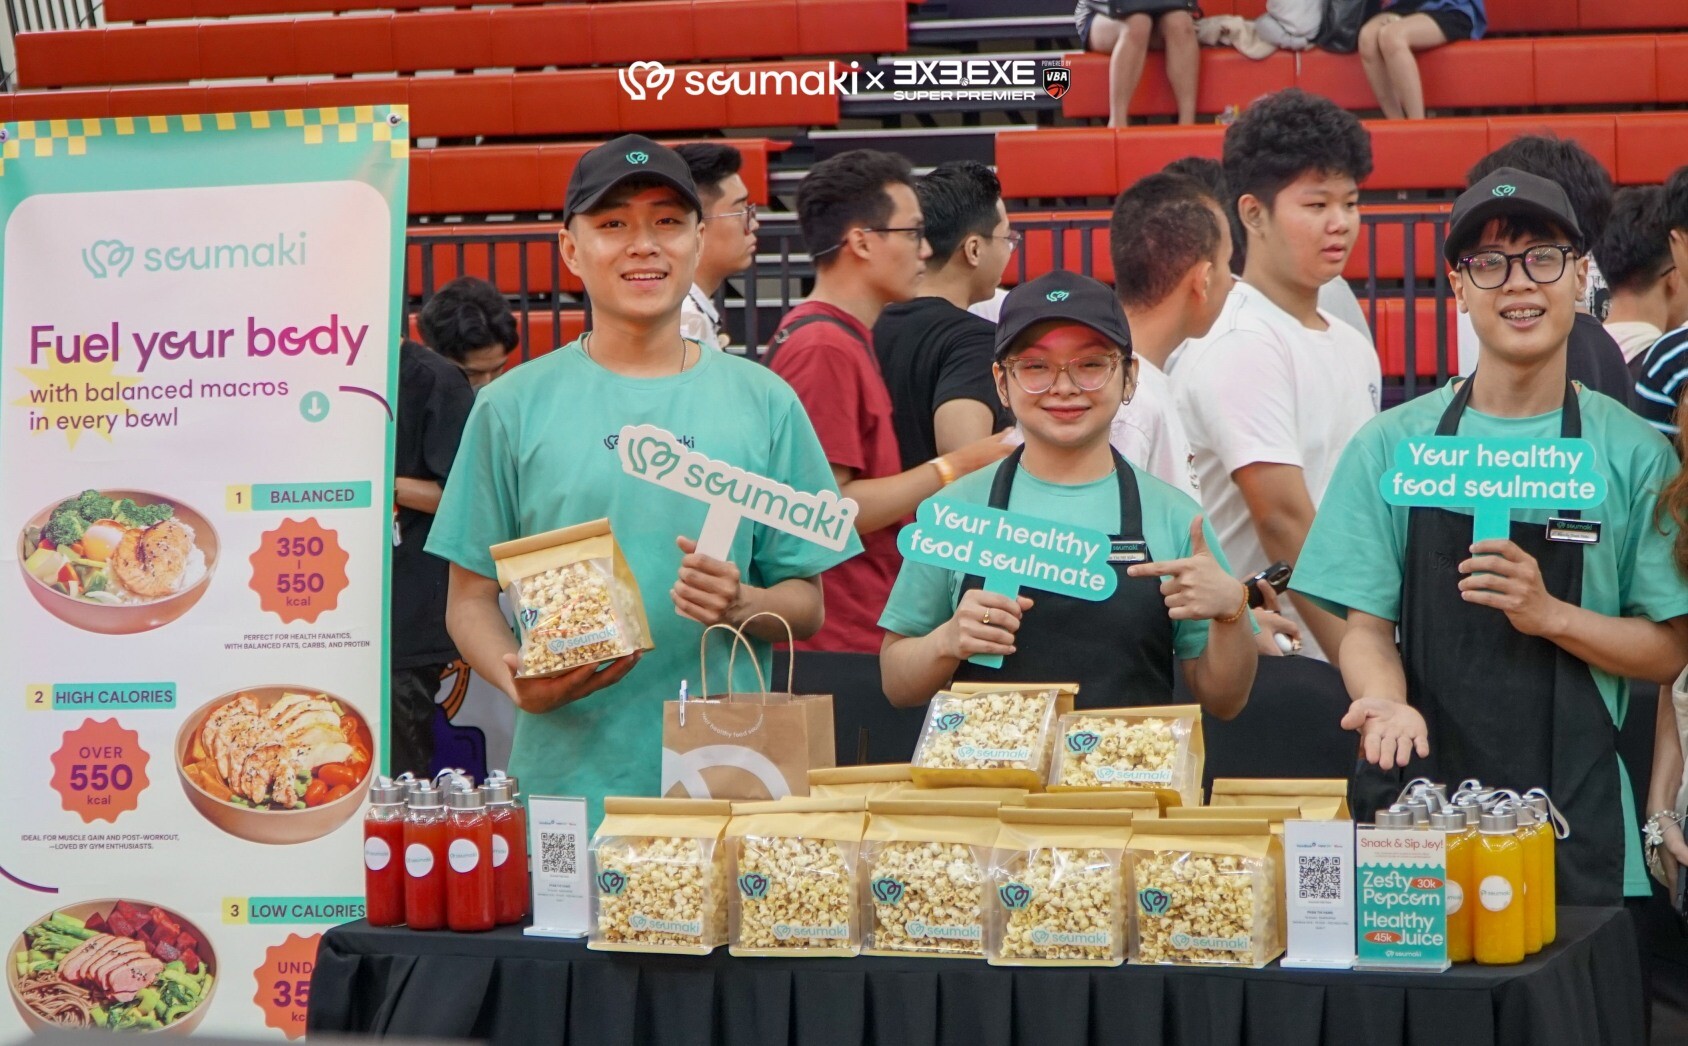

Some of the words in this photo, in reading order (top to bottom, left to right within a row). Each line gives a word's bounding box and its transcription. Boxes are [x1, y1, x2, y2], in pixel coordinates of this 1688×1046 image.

[144, 232, 307, 272] soumaki
[30, 322, 120, 365] Fuel
[133, 329, 235, 373] your
[247, 314, 370, 366] body
[30, 383, 78, 404] with
[85, 379, 193, 402] balanced
[200, 380, 289, 399] macros
[29, 410, 49, 431] in
[56, 412, 118, 434] every
[125, 408, 178, 428] bowl
[1408, 442, 1470, 467] Your
[1477, 444, 1584, 475] healthy
[1392, 472, 1456, 497] food
[1464, 474, 1596, 500] soulmate
[235, 492, 243, 505] 1
[270, 489, 355, 505] BALANCED
[683, 463, 849, 541] soumaki
[933, 502, 991, 536] Your
[996, 516, 1100, 564] healthy
[276, 537, 325, 557] 350
[910, 529, 974, 563] food
[978, 550, 1106, 592] soulmate
[276, 573, 325, 594] 550
[285, 595, 311, 608] kcal
[318, 632, 352, 640] FANATICS,
[566, 626, 618, 649] soumaki
[302, 641, 327, 649] CARBS,
[344, 640, 370, 648] PROTEIN
[34, 691, 44, 705] 2
[55, 691, 95, 706] HIGH
[98, 689, 173, 705] CALORIES
[79, 746, 123, 759] OVER
[976, 748, 1029, 759] soumaki
[69, 764, 133, 791] 550
[1115, 770, 1170, 781] soumaki
[86, 793, 111, 806] kcal
[1361, 837, 1392, 848] Snack
[1394, 839, 1402, 848] &
[1404, 838, 1420, 851] Sip
[1421, 840, 1444, 851] Joy!
[1363, 870, 1413, 893] Zesty
[1417, 879, 1436, 889] 30k
[1363, 888, 1441, 909] Popcorn
[231, 904, 239, 918] 3
[251, 904, 288, 918] LOW
[291, 904, 366, 918] CALORIES
[649, 919, 700, 933] soumaki
[1363, 911, 1435, 933] Healthy
[793, 925, 848, 937] soumaki
[926, 925, 981, 938] soumaki
[1052, 931, 1108, 945] soumaki
[1373, 932, 1392, 943] 45k
[1396, 928, 1444, 946] Juice
[1192, 936, 1249, 949] soumaki
[277, 962, 313, 974] UND
[273, 980, 310, 1008] 35
[291, 1012, 306, 1022] kc
